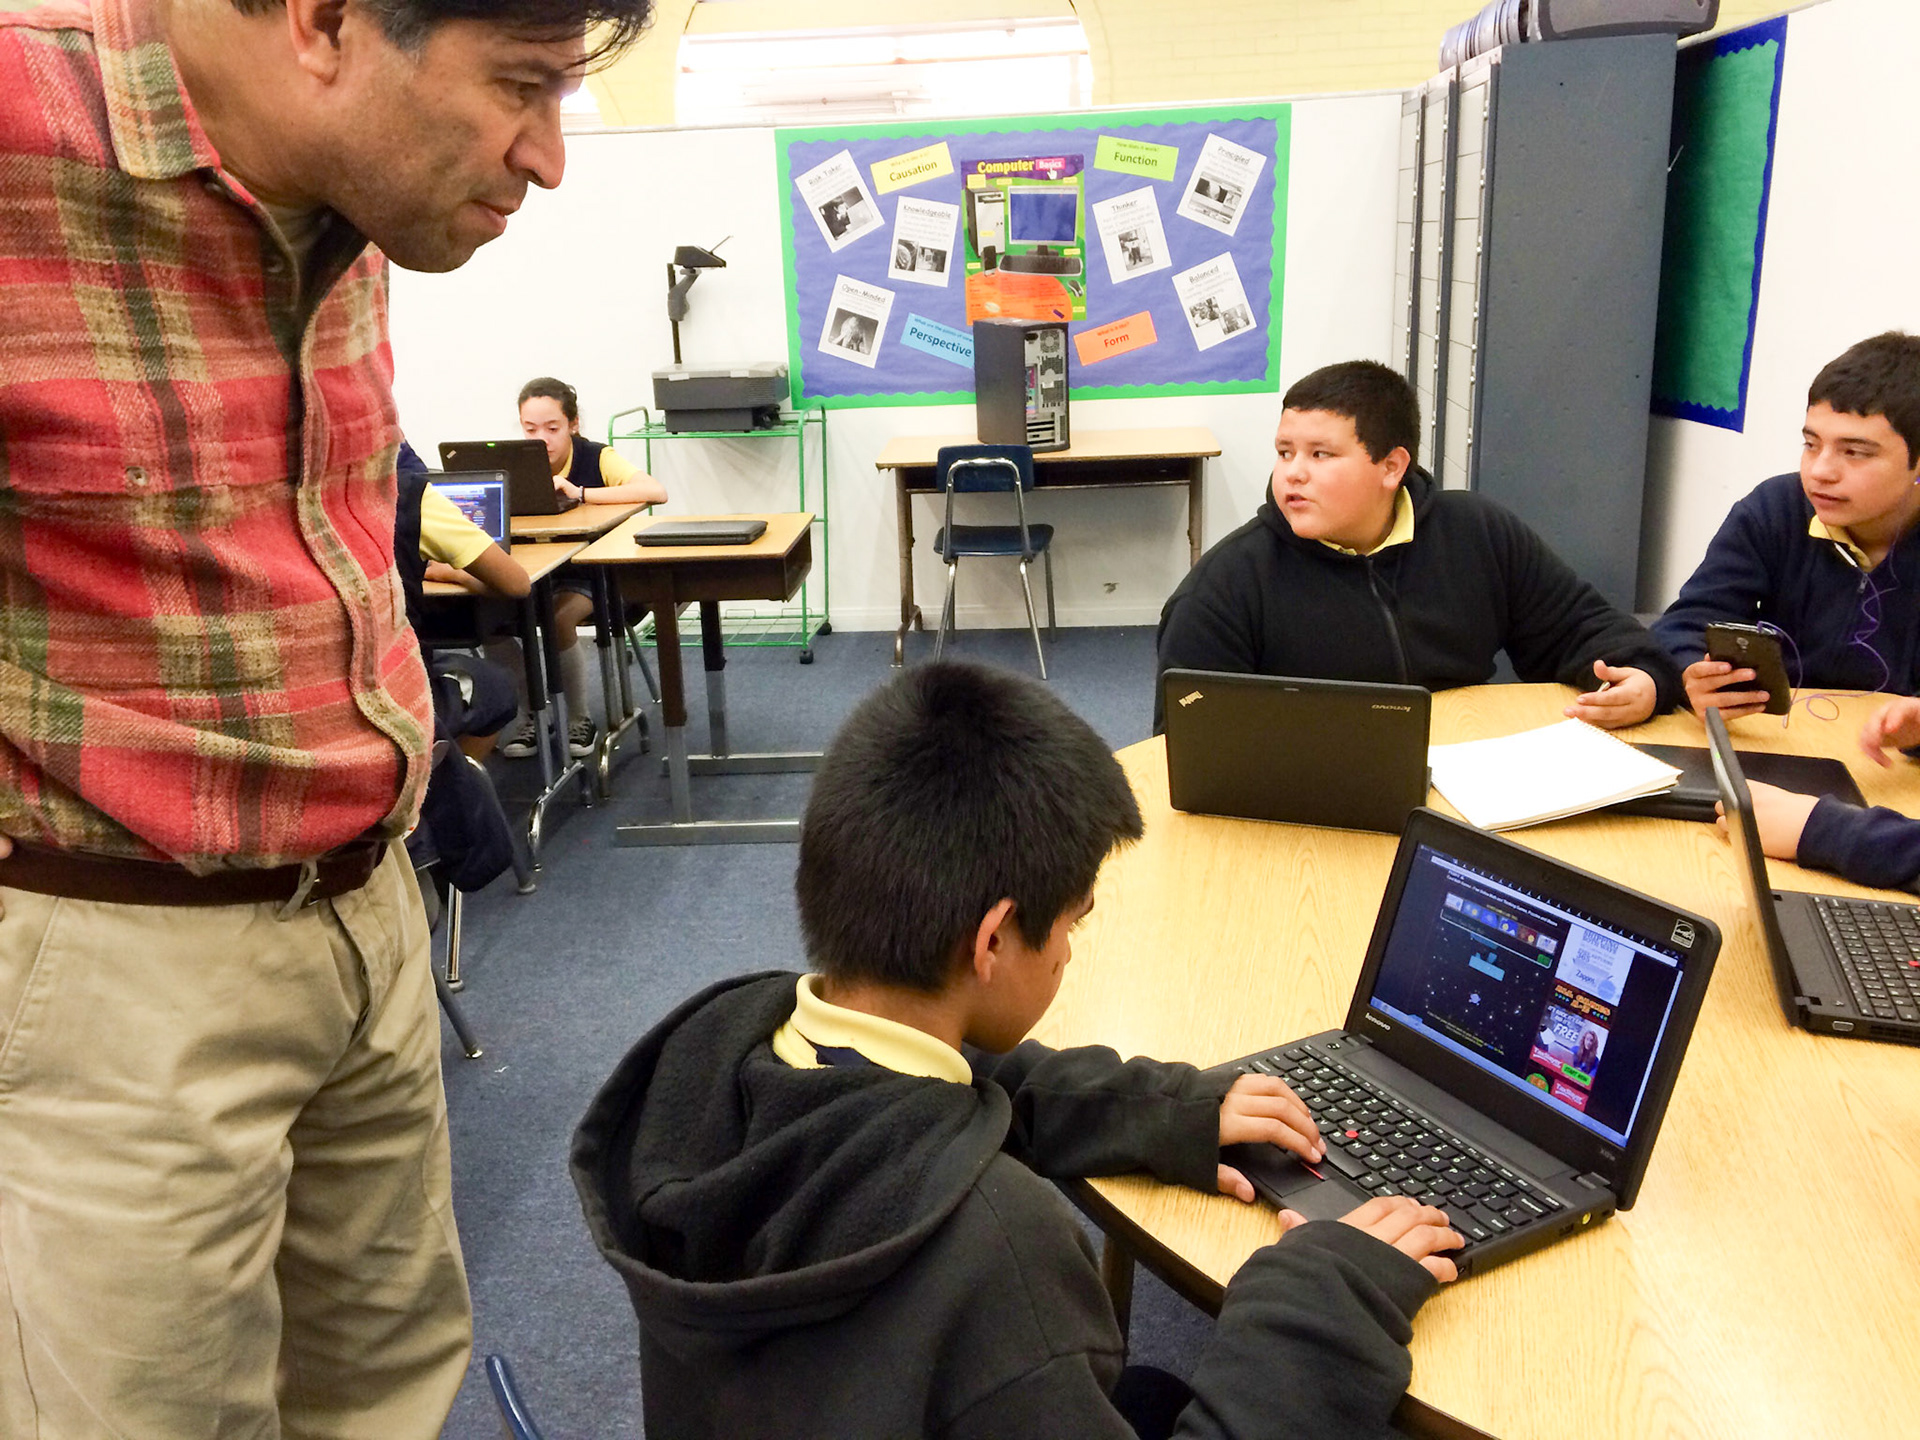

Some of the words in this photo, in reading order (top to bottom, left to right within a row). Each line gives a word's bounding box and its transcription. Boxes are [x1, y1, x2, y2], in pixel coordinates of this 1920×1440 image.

[1114, 151, 1158, 166] Function
[1217, 146, 1251, 165] Principled
[889, 161, 938, 181] Causation
[977, 160, 1035, 174] Computer
[1038, 160, 1063, 168] Basics
[903, 205, 952, 218] Knowledgeable
[1111, 200, 1138, 212] Thinker
[1189, 264, 1219, 283] Balanced
[909, 327, 972, 357] Perspective
[1104, 334, 1130, 348] Form
[1371, 704, 1411, 712] lenovo
[1365, 1012, 1391, 1031] lenovo
[1553, 1023, 1579, 1042] FREE
